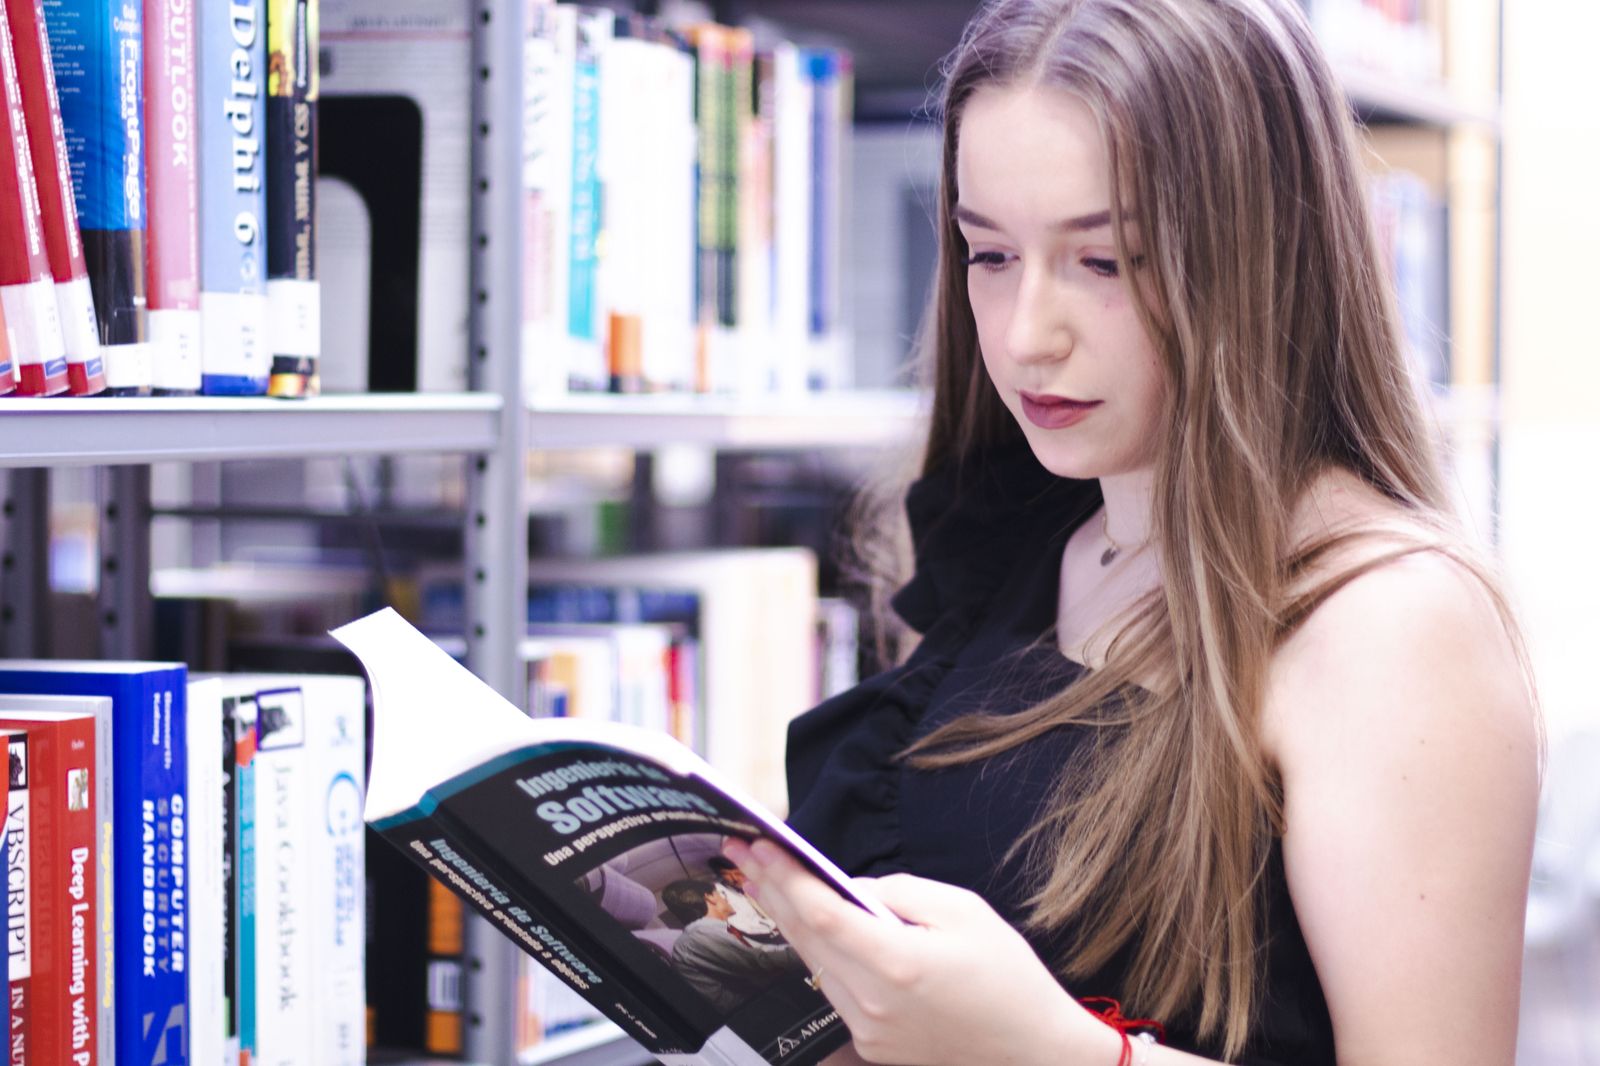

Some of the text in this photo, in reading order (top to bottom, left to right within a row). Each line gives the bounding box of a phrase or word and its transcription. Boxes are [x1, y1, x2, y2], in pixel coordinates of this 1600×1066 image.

[126, 39, 141, 220] FrontPage
[170, 0, 188, 167] OUTLOOK
[224, 1, 260, 195] Delphi
[15, 135, 40, 256] Programación
[56, 141, 80, 258] Programación
[70, 847, 89, 899] Deep
[536, 785, 719, 835] Software
[543, 843, 574, 866] Una
[572, 812, 652, 852] perspectiva
[7, 803, 26, 962] VBSCRIPT
[142, 800, 155, 977] HANDBOOK
[157, 798, 169, 973] SECURITY
[171, 794, 184, 973] COMPUTER
[410, 839, 433, 859] Una
[429, 858, 495, 910] perspectiva
[493, 909, 544, 951] orientada
[551, 958, 589, 990] objetos
[429, 838, 603, 983] Ingeniería de Software
[11, 986, 24, 1009] IN
[70, 904, 89, 995] Learning
[12, 1014, 24, 1030] A
[72, 998, 90, 1049] with
